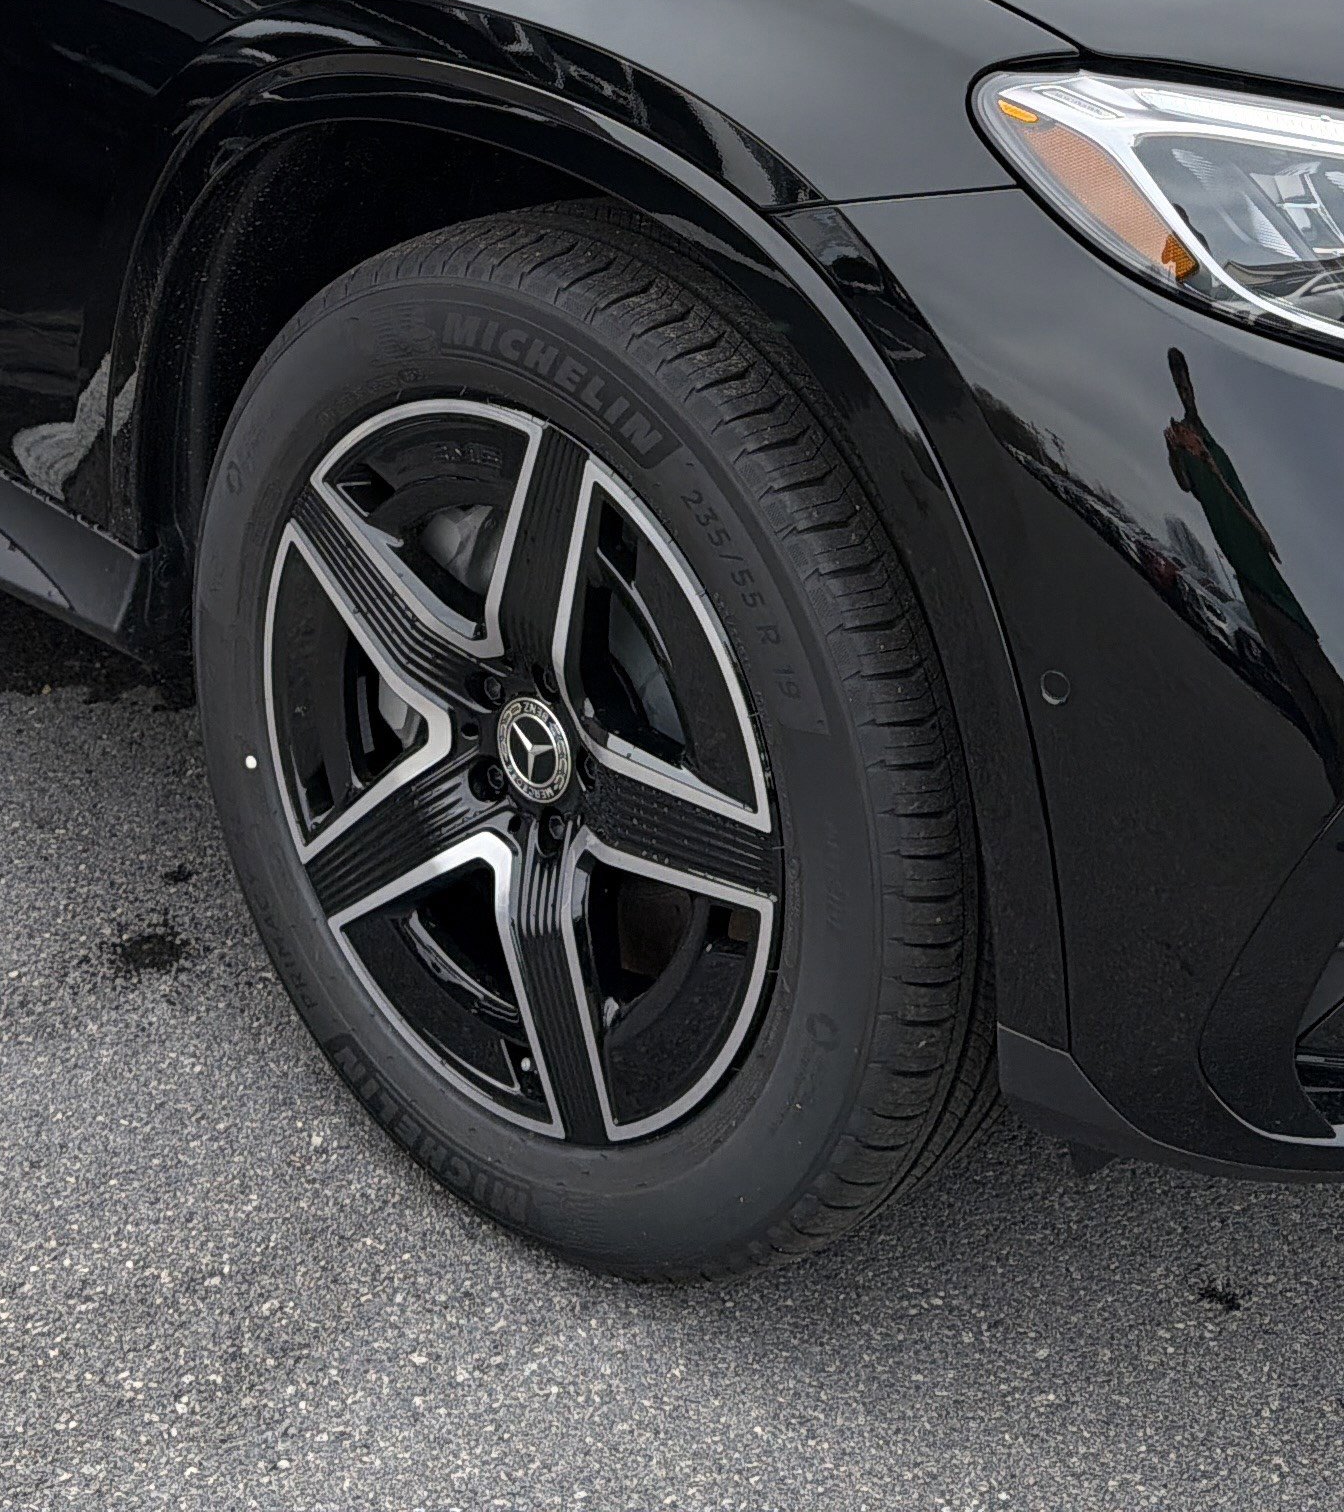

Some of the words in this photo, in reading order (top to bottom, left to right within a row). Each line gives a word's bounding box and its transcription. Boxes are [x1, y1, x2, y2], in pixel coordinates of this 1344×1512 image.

[440, 311, 665, 456] MICHELIN
[680, 488, 768, 610] 235/55
[756, 624, 782, 647] R
[334, 1041, 536, 1223] MICHELIN
